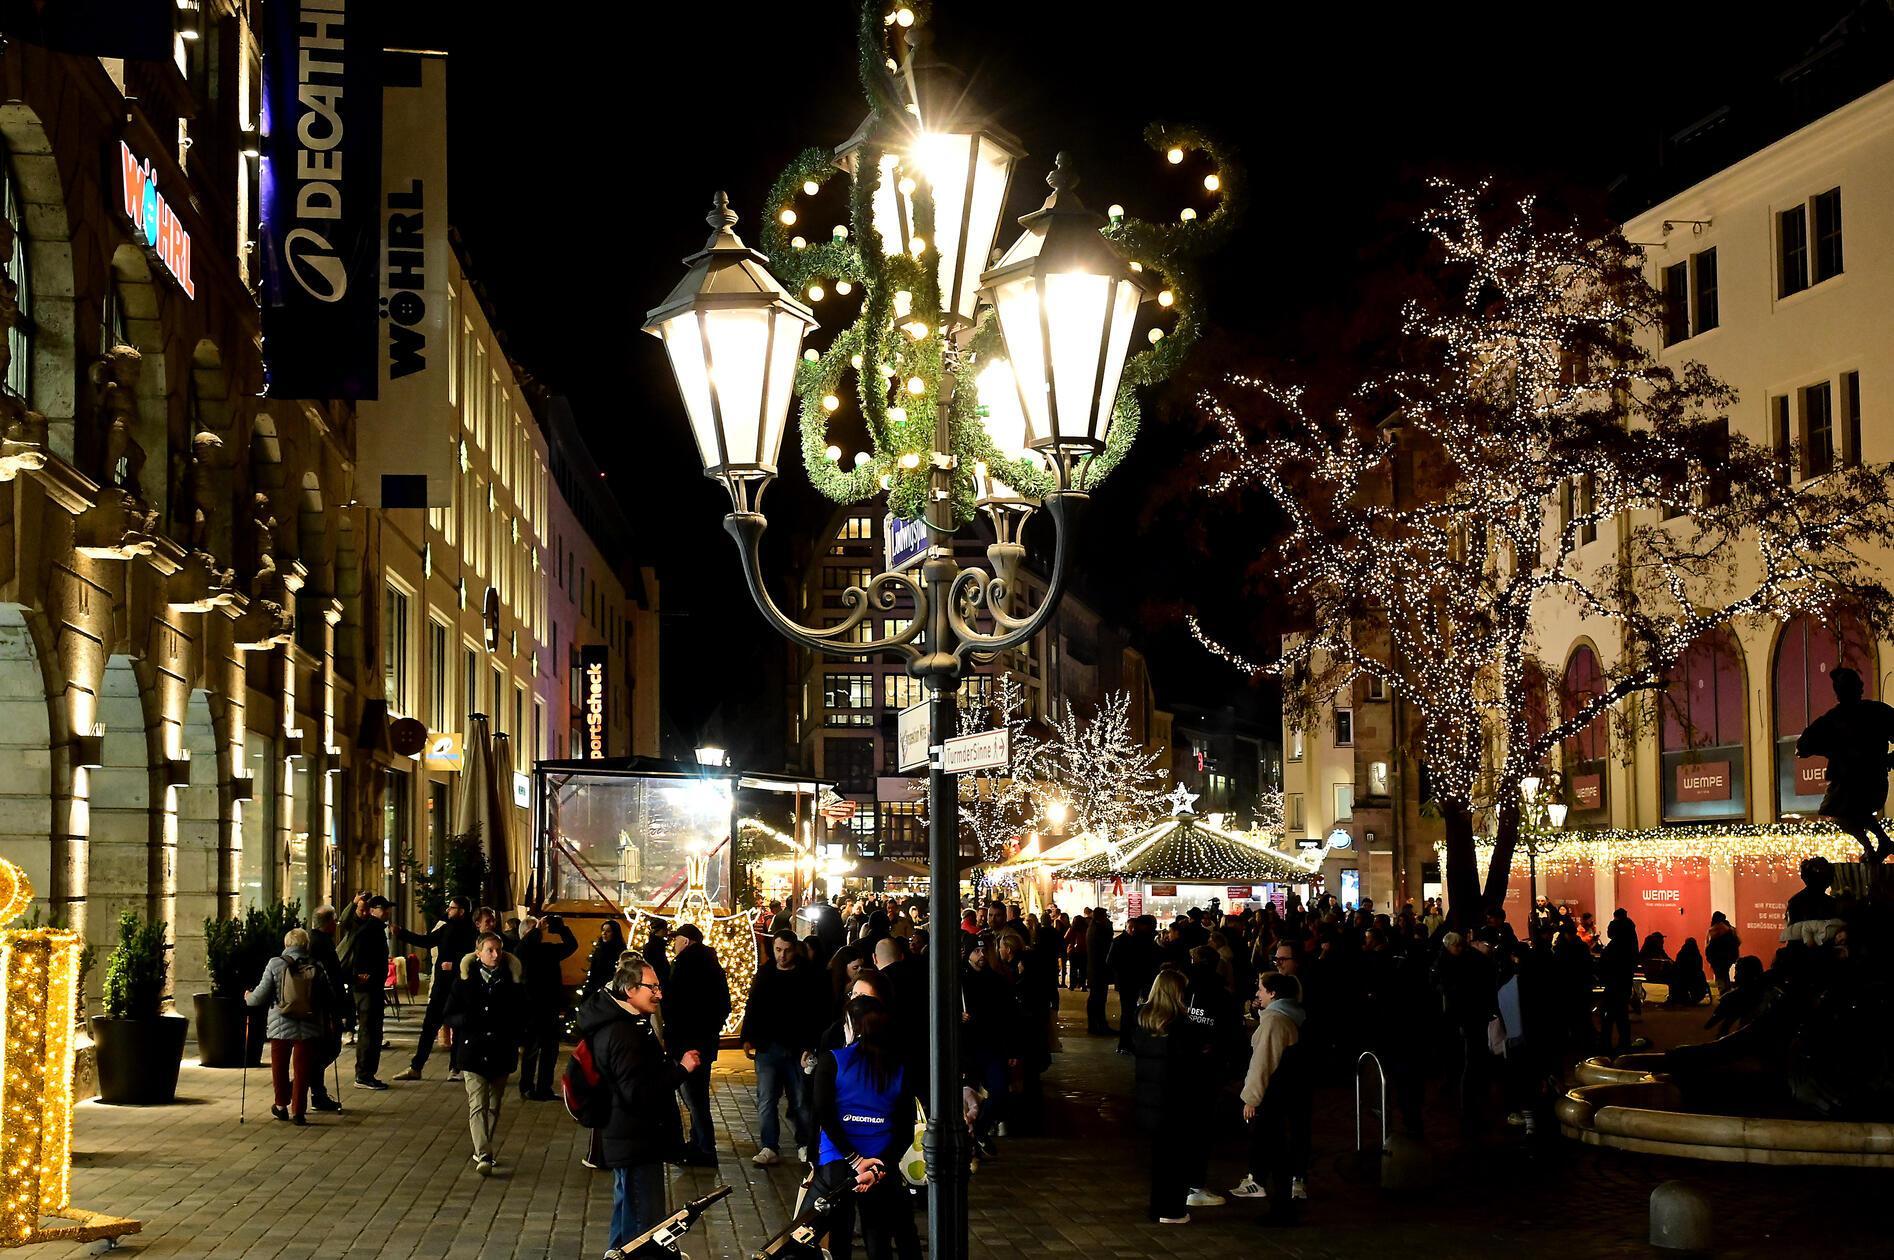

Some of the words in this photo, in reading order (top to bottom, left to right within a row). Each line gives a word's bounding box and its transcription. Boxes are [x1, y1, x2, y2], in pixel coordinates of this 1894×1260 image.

[121, 140, 194, 300] WÖHRL
[379, 179, 426, 380] WÖHRL
[587, 663, 605, 759] portScheck
[947, 743, 991, 765] TurmderSinne
[1576, 786, 1598, 799] WEMPE
[1683, 775, 1723, 789] WEMPE
[1642, 889, 1680, 901] WEMPE
